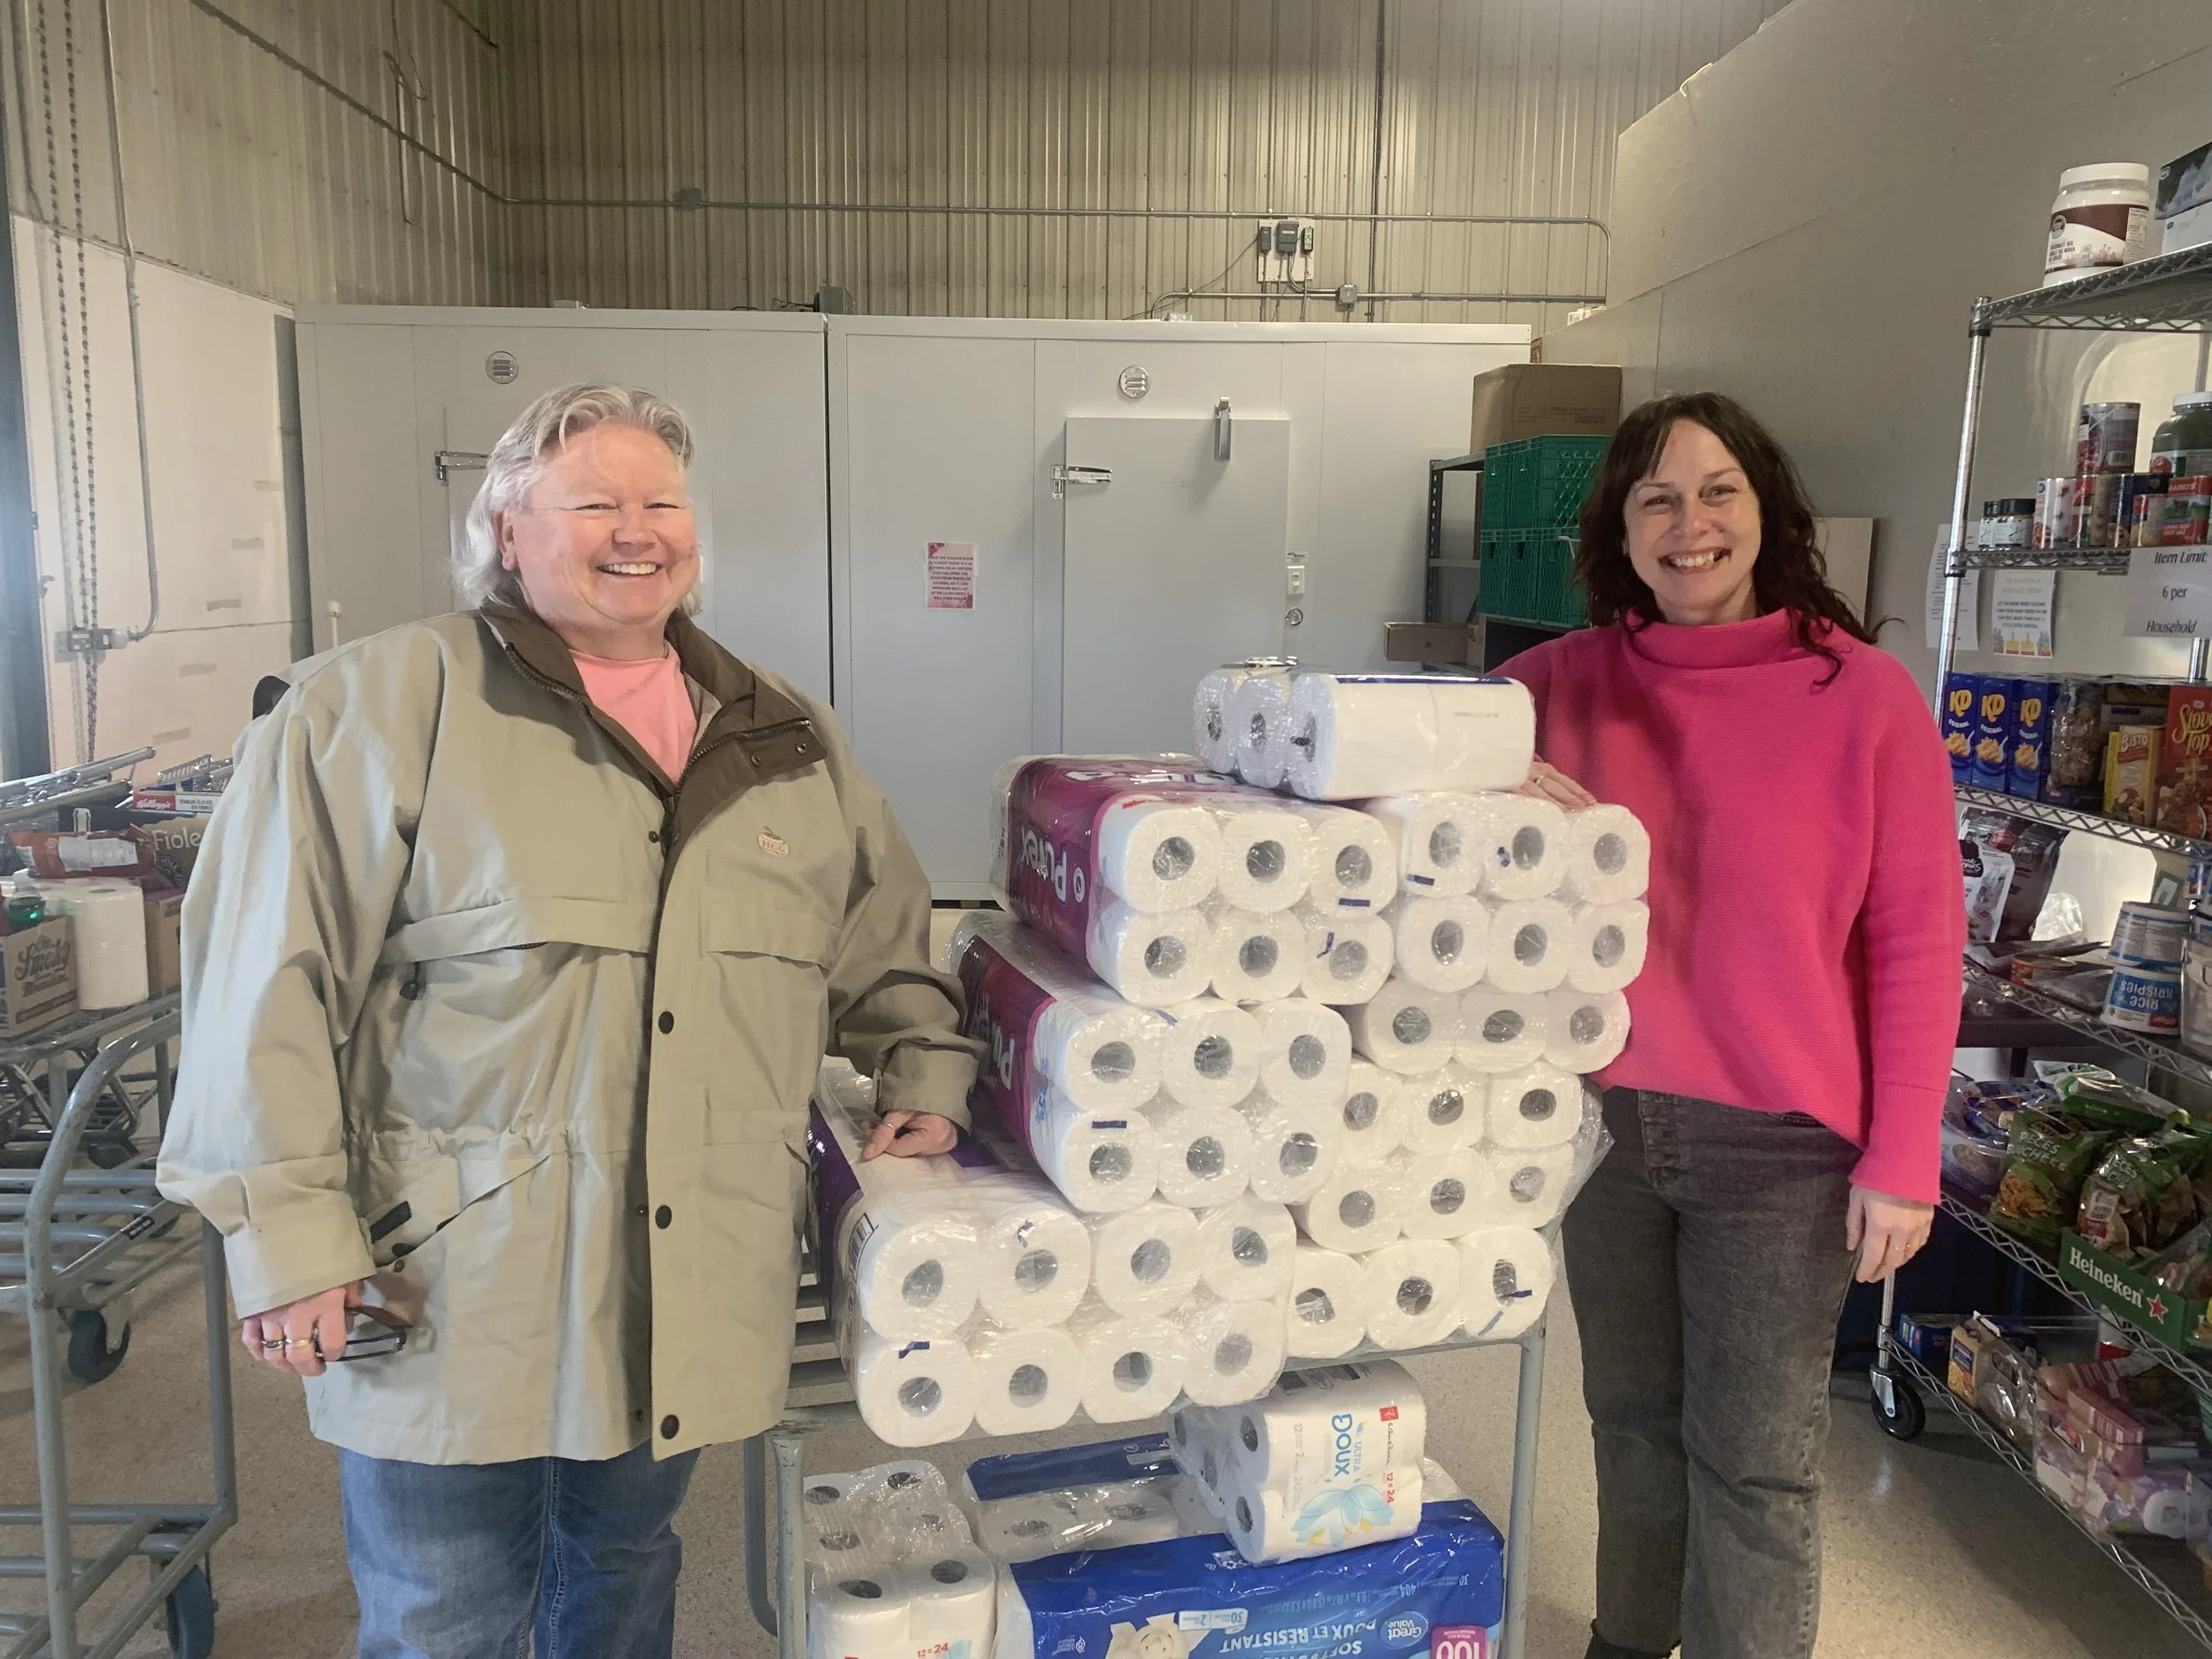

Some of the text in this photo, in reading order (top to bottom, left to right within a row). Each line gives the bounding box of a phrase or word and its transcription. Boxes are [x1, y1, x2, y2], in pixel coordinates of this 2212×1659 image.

[2154, 551, 2177, 564] Item
[2162, 586, 2188, 601] 6 per
[2146, 619, 2197, 633] Household
[2185, 733, 2210, 757] Top
[2069, 1247, 2143, 1308] Heineken
[1332, 1413, 1354, 1477] DOUX
[1353, 1441, 1363, 1473] ULTRA
[1230, 1611, 1244, 1624] 30
[1386, 1618, 1415, 1631] Value
[1217, 1617, 1378, 1654] DOUX ET RÉSISTANT
[1386, 1626, 1423, 1641] Great
